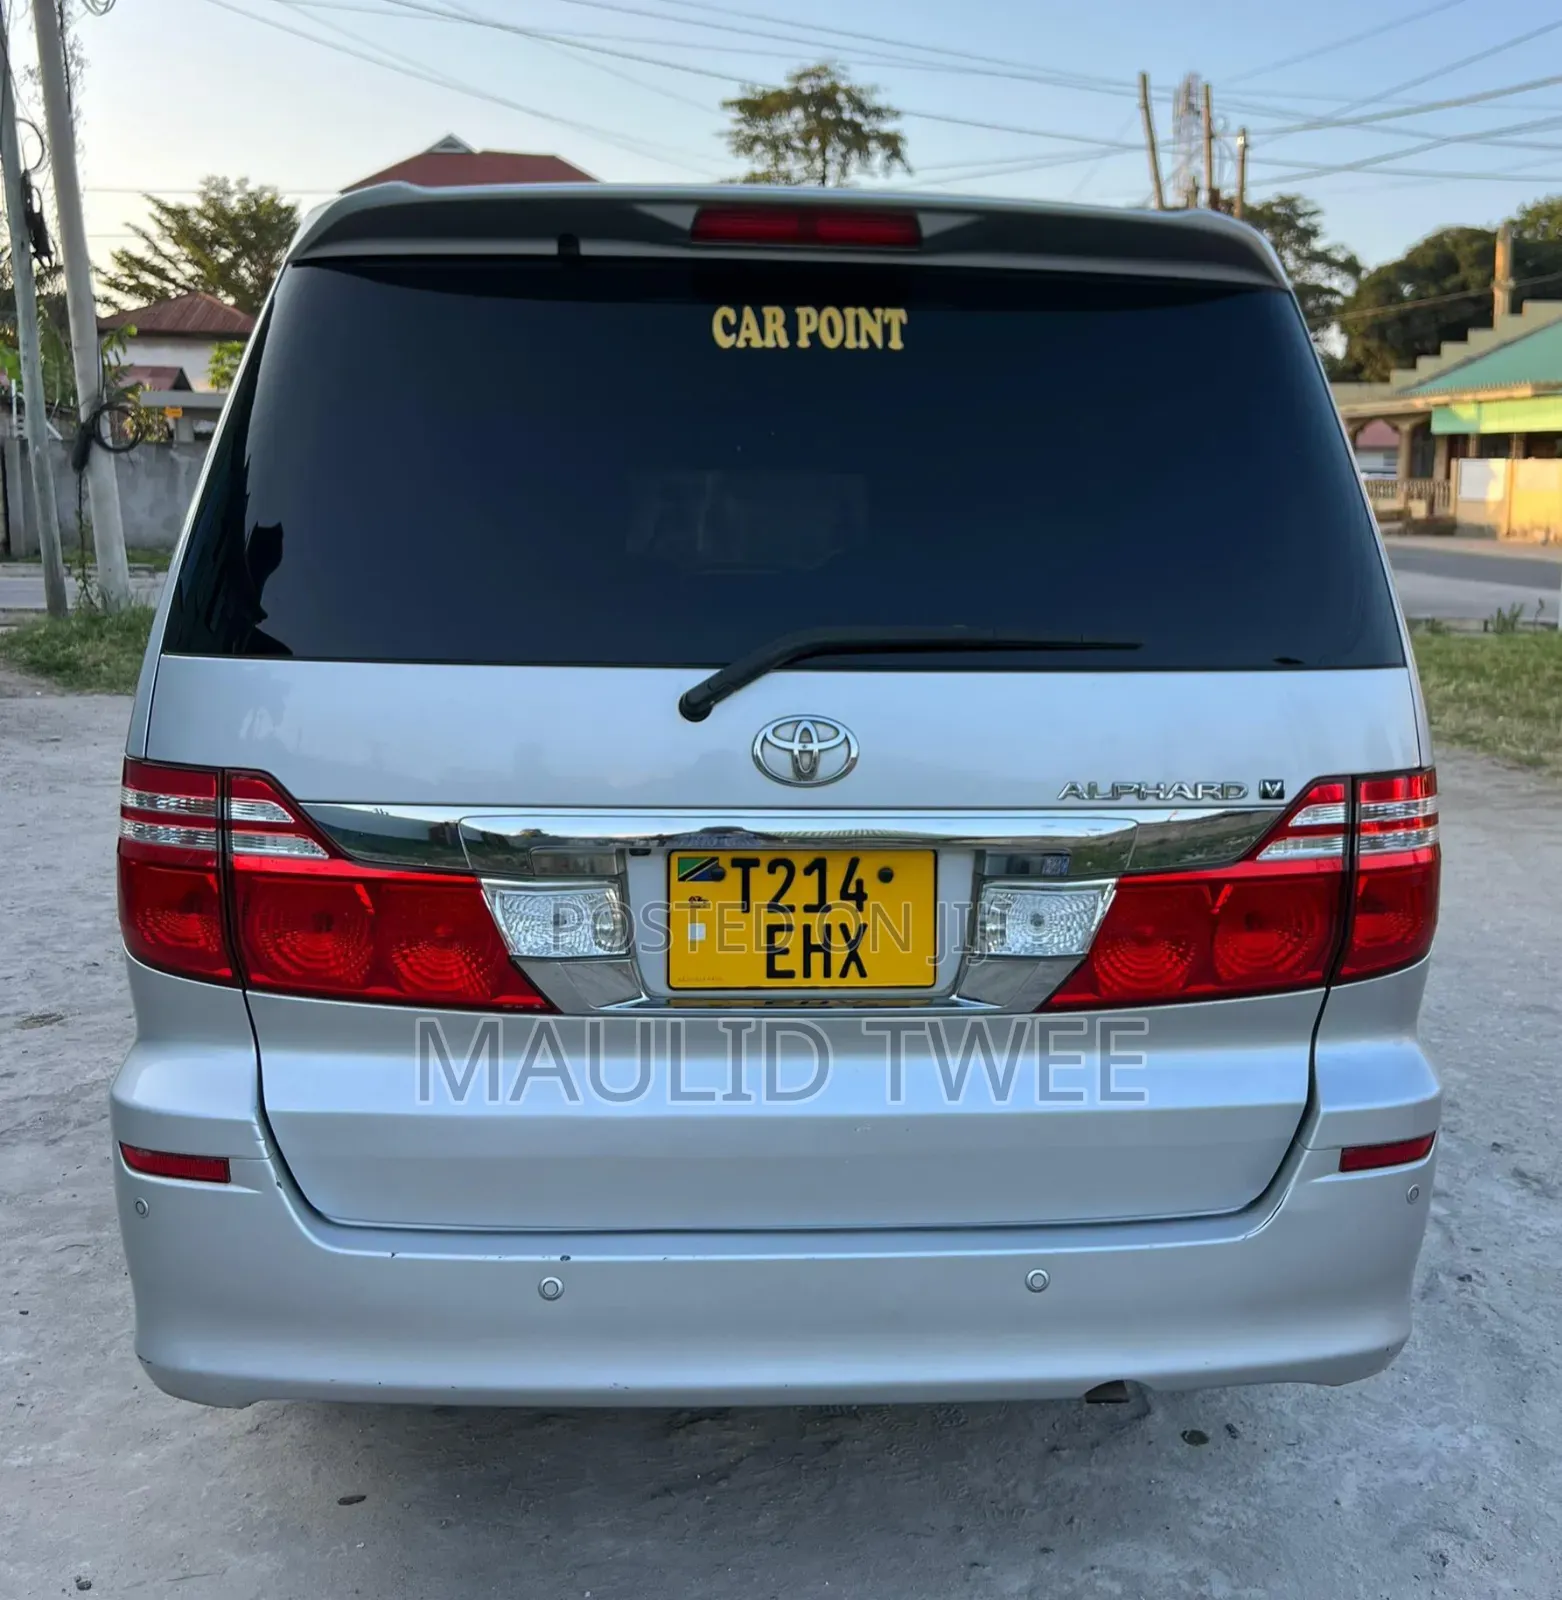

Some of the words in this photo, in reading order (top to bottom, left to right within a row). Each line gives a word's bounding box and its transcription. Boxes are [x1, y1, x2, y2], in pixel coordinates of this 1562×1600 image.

[712, 305, 790, 349] CAR
[795, 306, 908, 350] POINT
[1057, 781, 1248, 800] ALPHARD
[731, 857, 868, 913] T214
[766, 923, 868, 978] EHX
